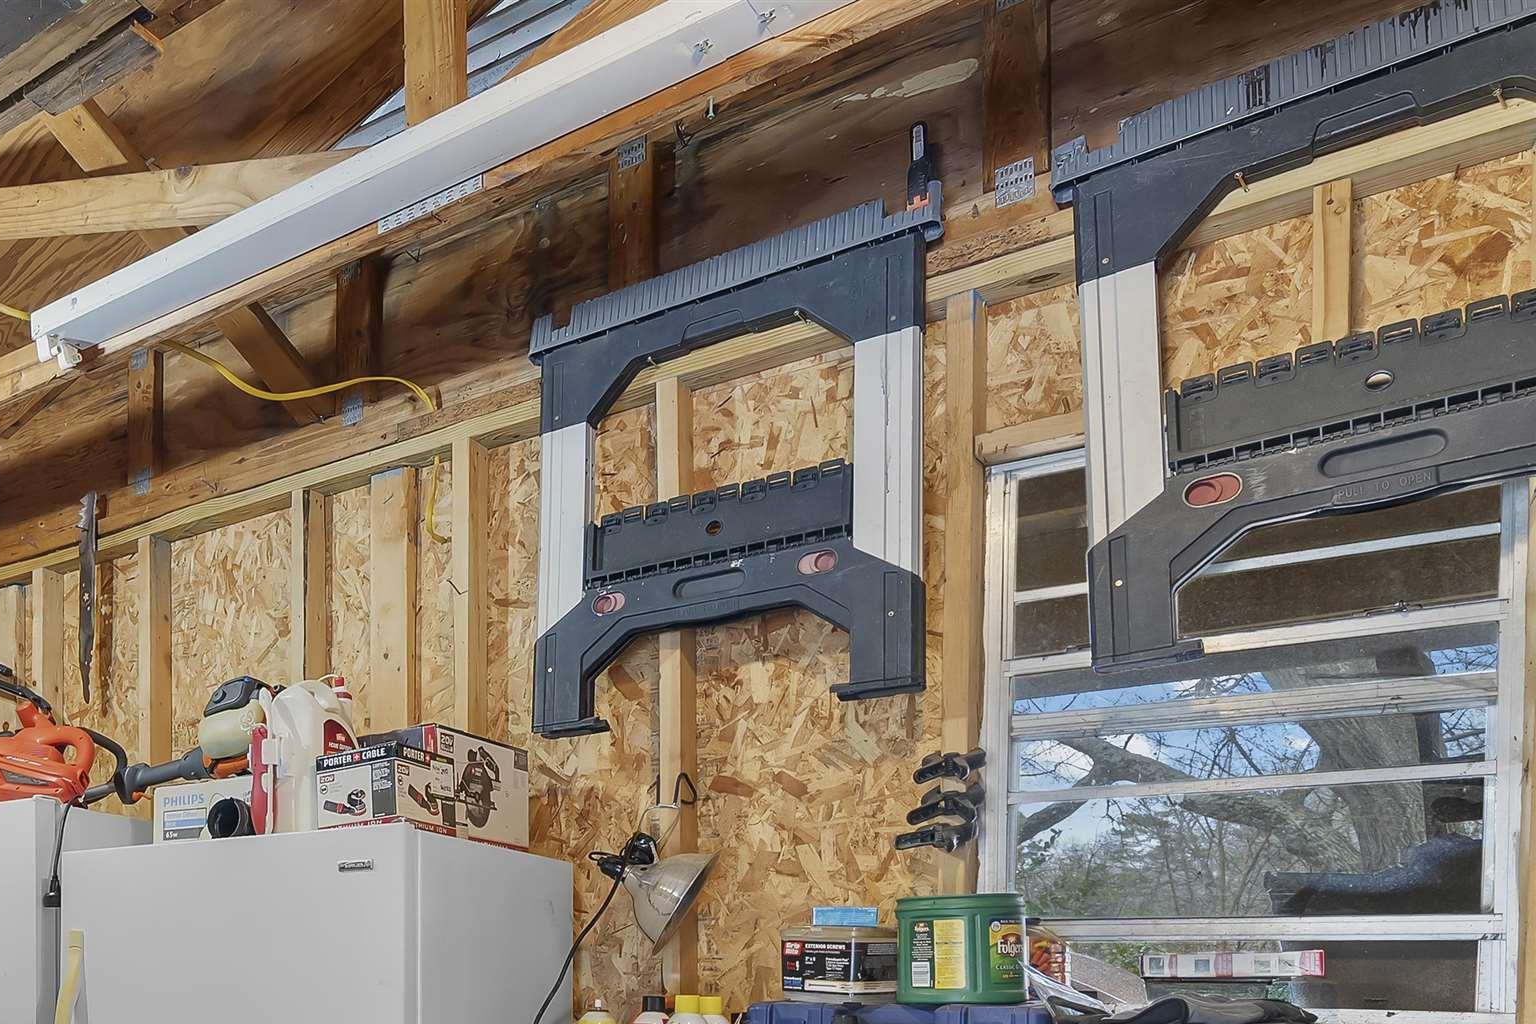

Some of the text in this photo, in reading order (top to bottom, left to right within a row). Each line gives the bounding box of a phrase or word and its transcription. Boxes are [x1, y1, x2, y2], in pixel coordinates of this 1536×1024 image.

[1399, 471, 1432, 487] OPEN
[323, 747, 387, 768] PORTER CABLE
[403, 747, 424, 761] PORTER
[163, 792, 205, 808] PHILIPS
[997, 939, 1024, 957] Folgers
